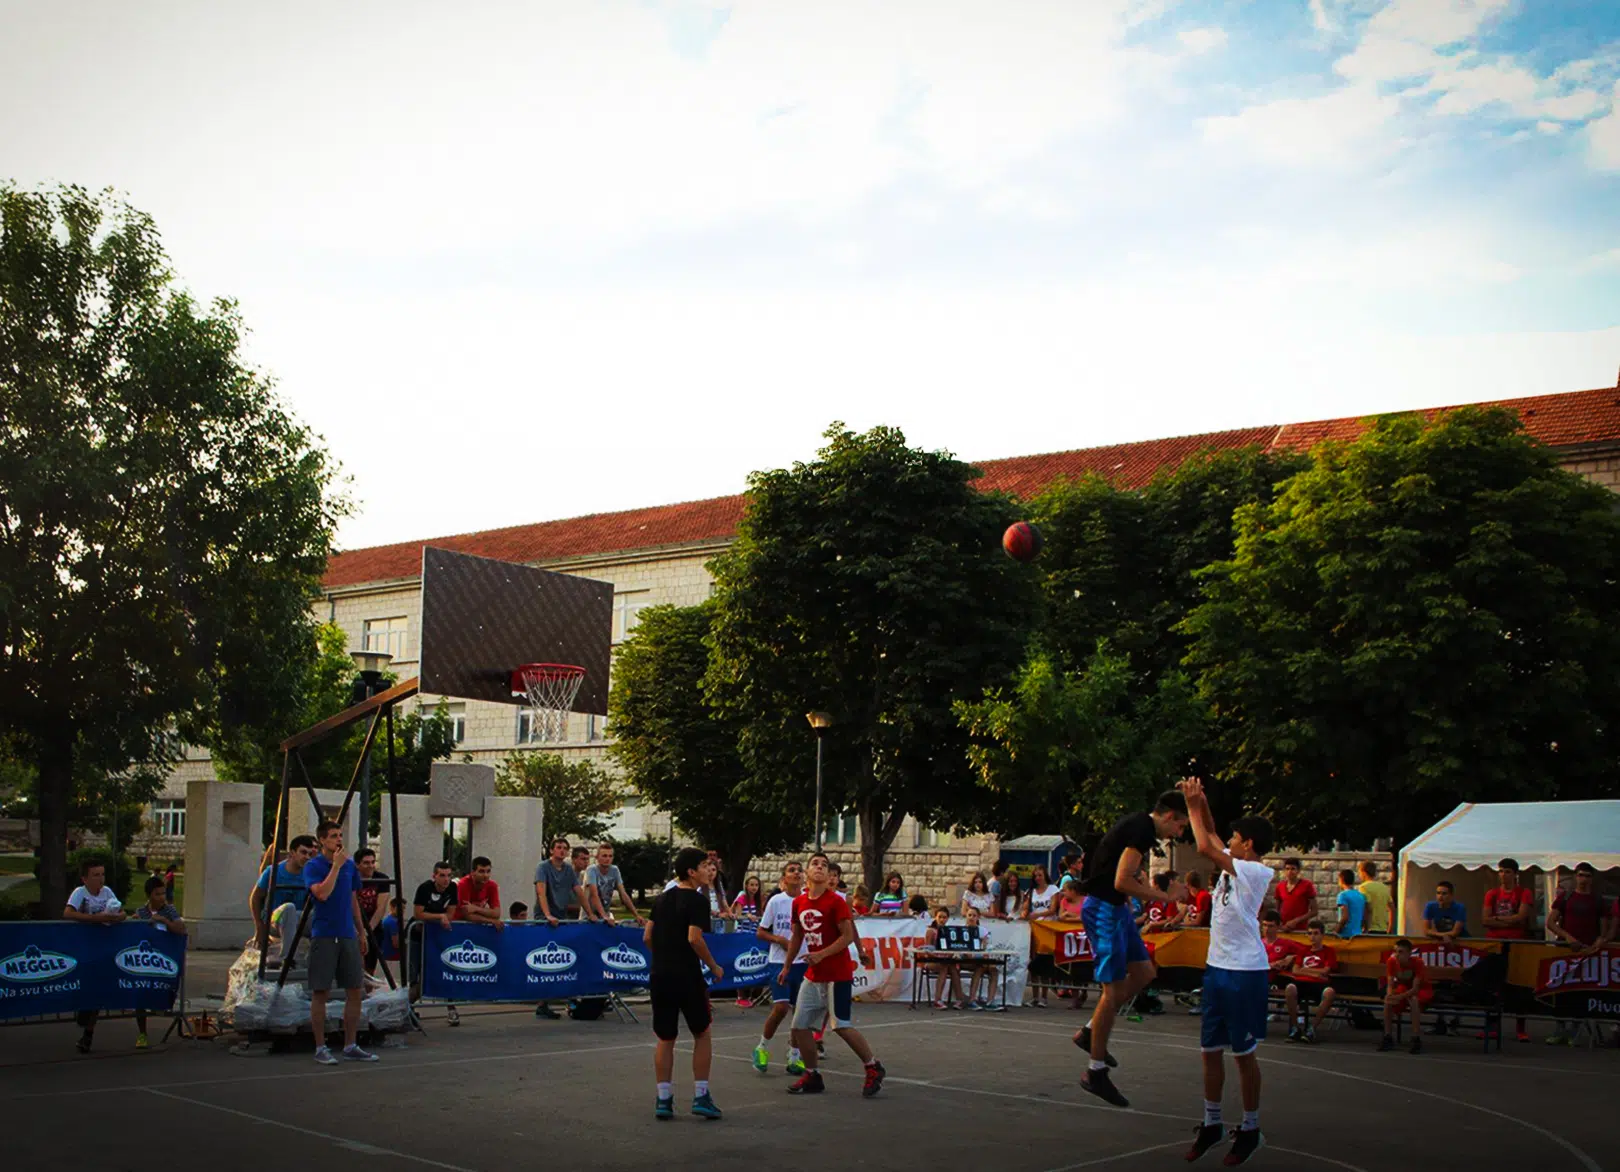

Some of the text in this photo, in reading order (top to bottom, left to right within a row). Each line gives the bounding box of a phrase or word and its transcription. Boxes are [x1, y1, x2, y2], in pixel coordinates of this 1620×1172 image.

[124, 954, 174, 972] MEGGLE
[449, 951, 490, 964] MEGGLE
[533, 953, 571, 965] MEGGLE
[607, 951, 643, 966] MEGGLE
[5, 958, 67, 975] MEGGLE
[442, 971, 454, 981] Na
[456, 974, 470, 983] svu
[527, 973, 538, 983] Na
[540, 974, 555, 983] svu
[603, 970, 614, 980] Na
[616, 972, 628, 981] svu
[118, 977, 133, 989] Na
[0, 986, 16, 999] Na
[20, 984, 40, 996] svu
